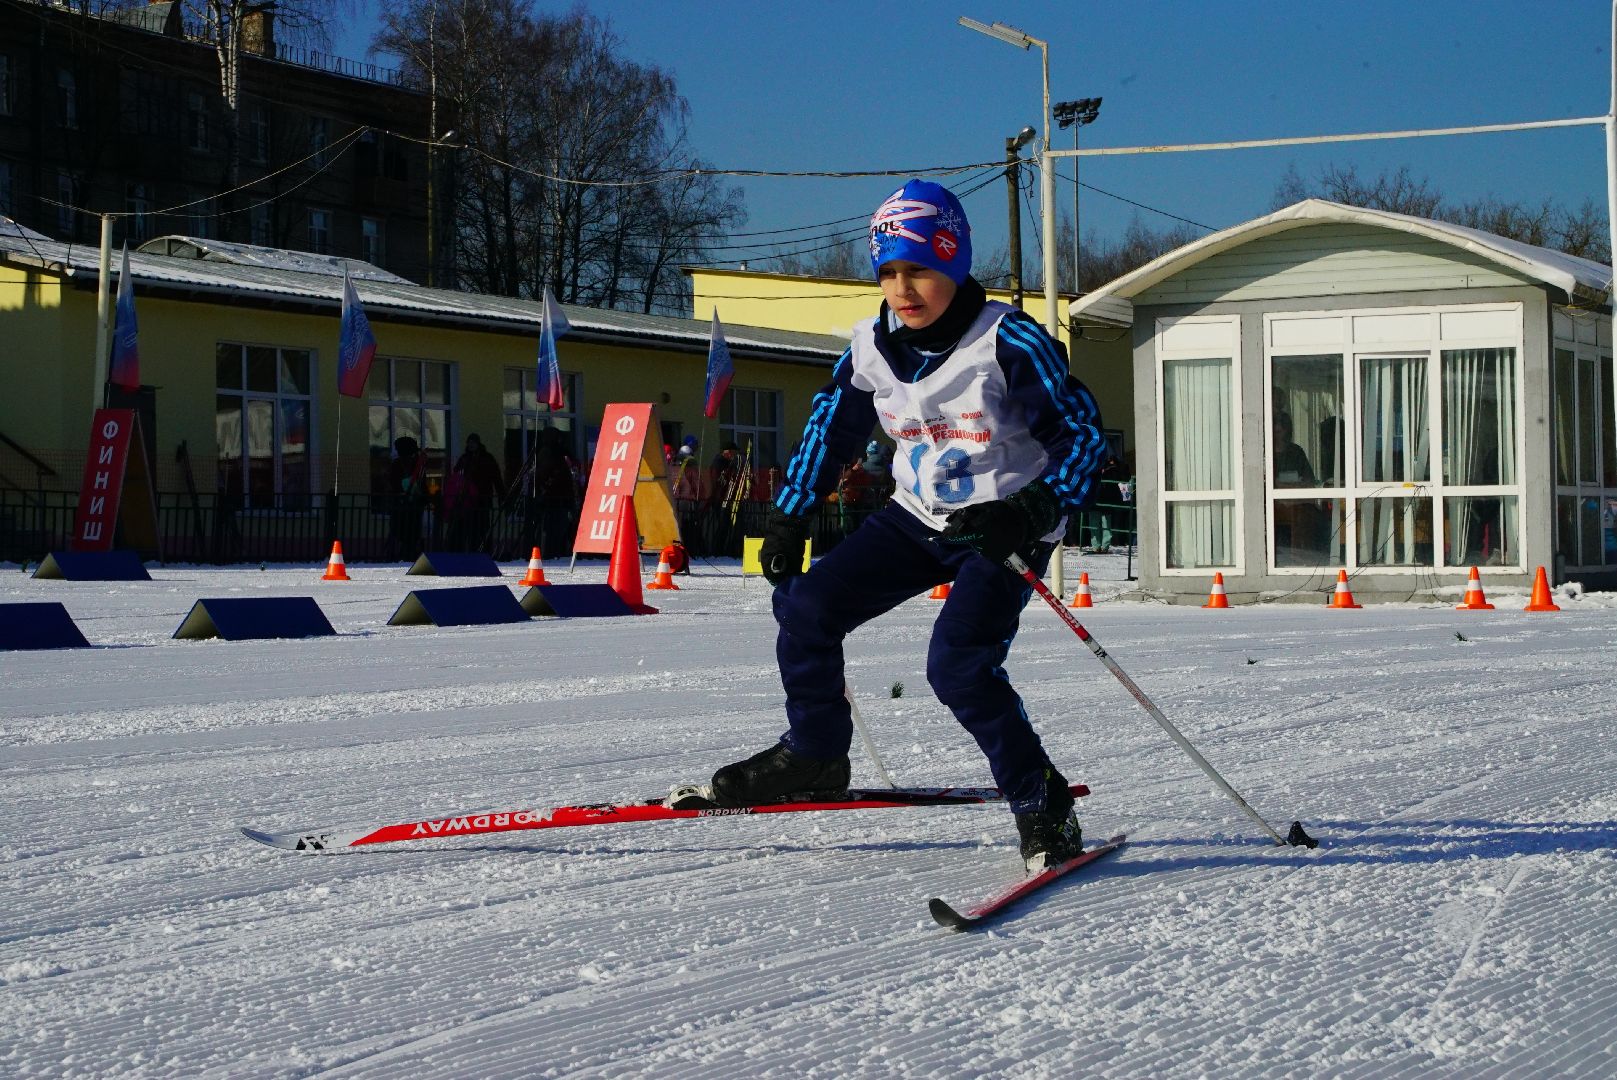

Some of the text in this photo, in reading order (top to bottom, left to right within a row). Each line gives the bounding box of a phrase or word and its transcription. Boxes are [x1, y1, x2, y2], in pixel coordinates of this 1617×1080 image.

[83, 420, 119, 540] ФИНИШ
[590, 415, 635, 539] ФИНИШ
[411, 809, 554, 836] NORDWAY
[697, 807, 754, 818] NORDWAY
